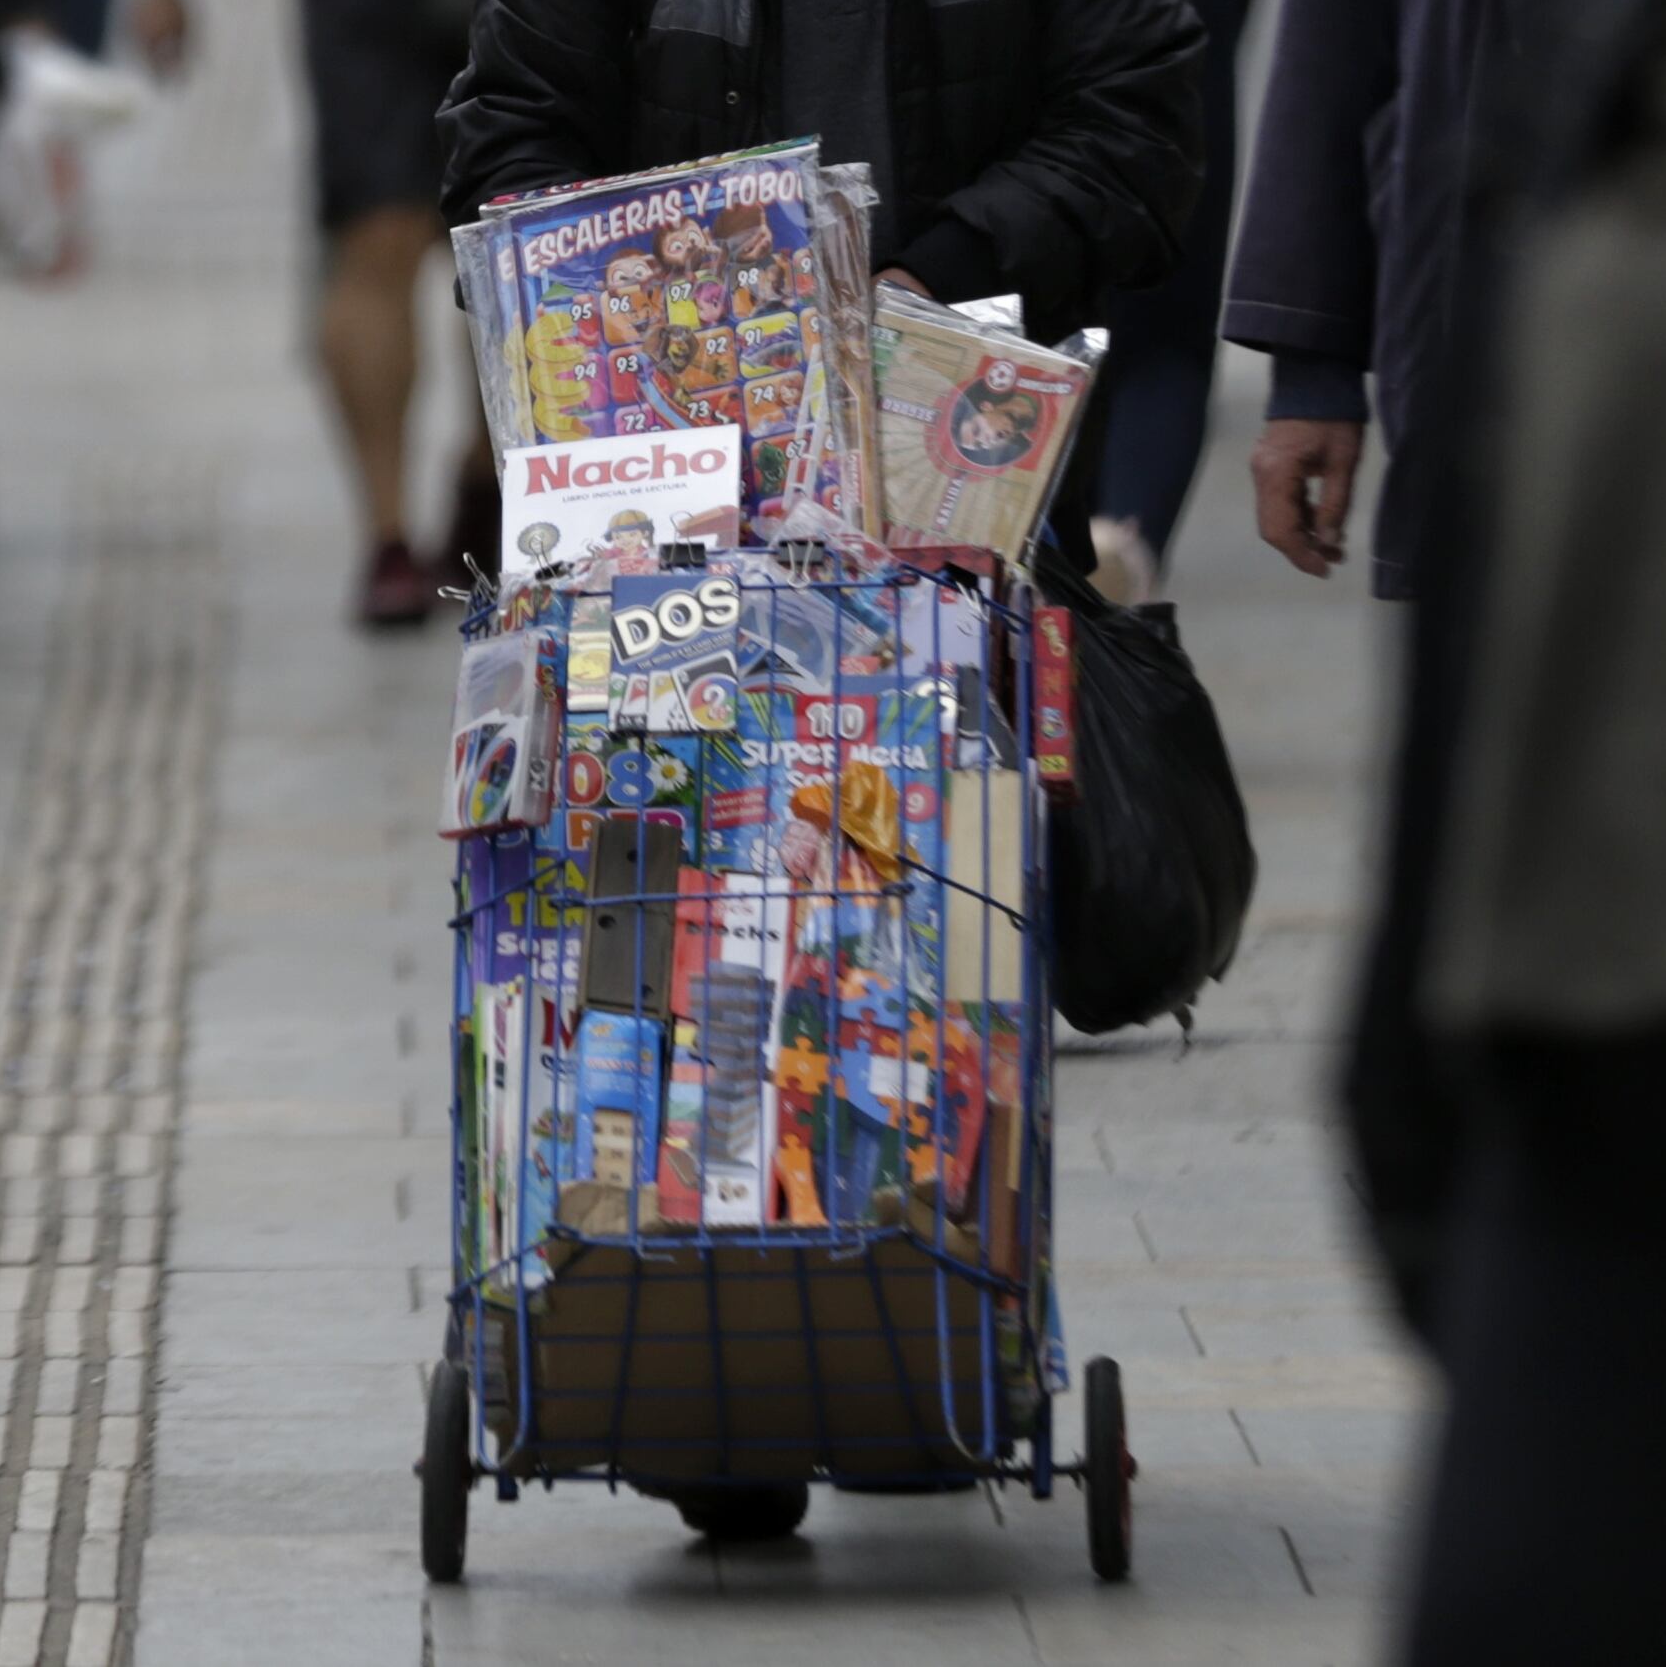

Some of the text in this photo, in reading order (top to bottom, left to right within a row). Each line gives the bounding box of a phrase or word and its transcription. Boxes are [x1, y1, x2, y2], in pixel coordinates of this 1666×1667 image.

[523, 189, 683, 277] ESCALERAS
[689, 180, 713, 216] Y
[737, 267, 760, 287] 98
[670, 283, 692, 302] 97
[571, 302, 593, 322] 95
[609, 295, 630, 314] 96
[705, 337, 728, 355] 92
[744, 328, 762, 345] 91
[574, 363, 597, 381] 94
[616, 356, 639, 374] 93
[752, 385, 775, 404] 74
[686, 400, 710, 420] 73
[623, 413, 647, 431] 72
[524, 444, 727, 497] Nacho
[562, 481, 689, 503] LIBRO INICIAL DE LECTURA
[614, 576, 740, 658] DOS
[805, 701, 866, 740] 110
